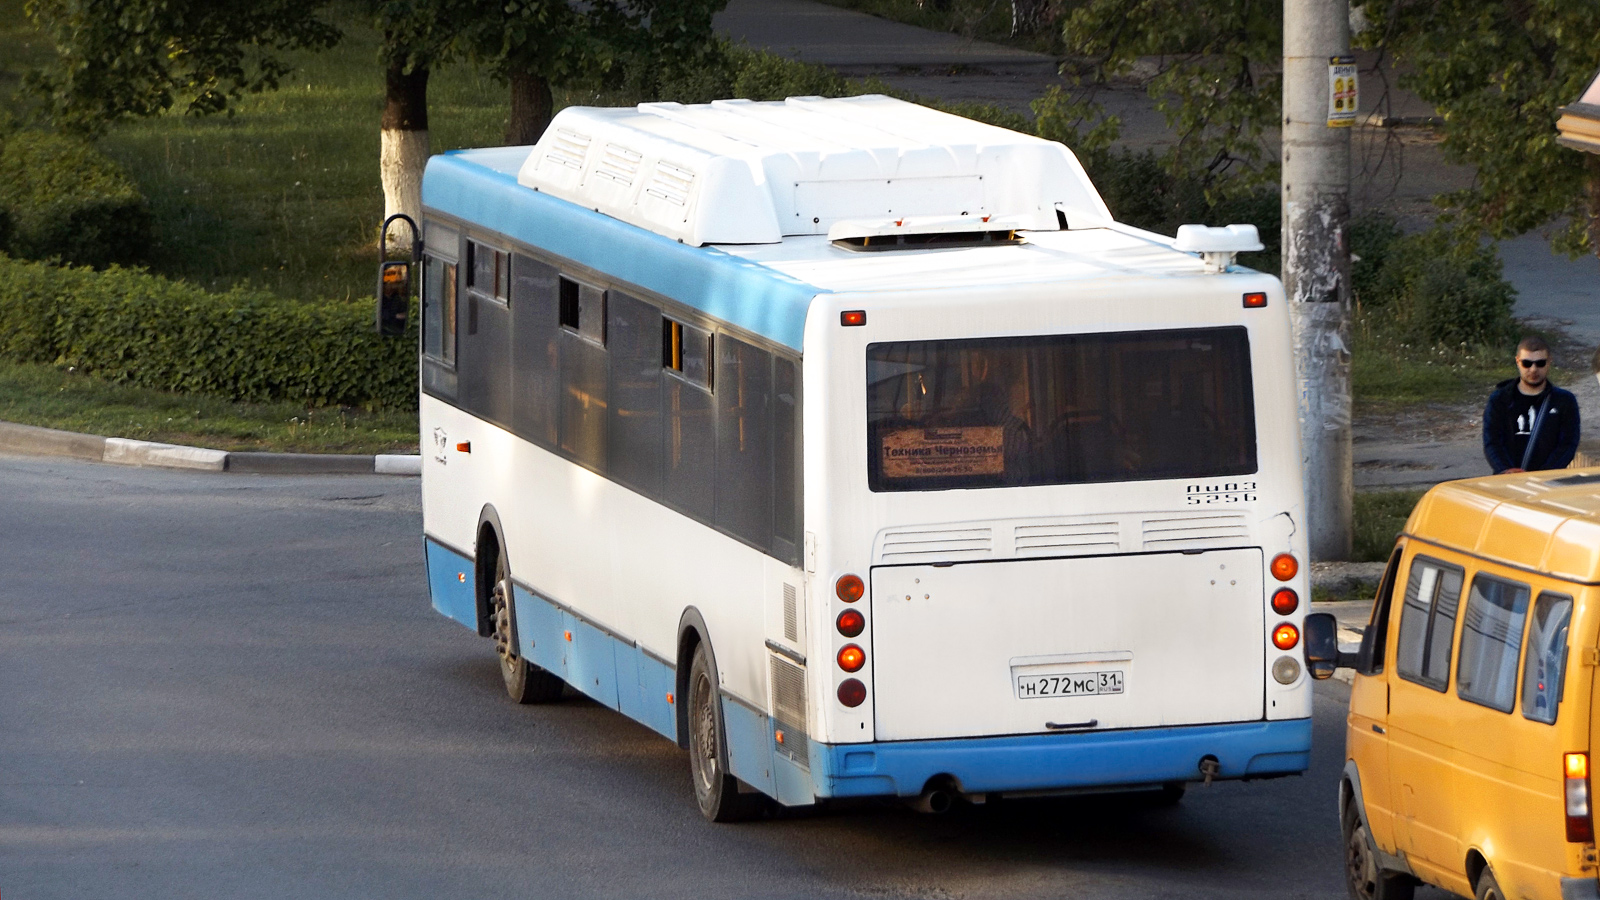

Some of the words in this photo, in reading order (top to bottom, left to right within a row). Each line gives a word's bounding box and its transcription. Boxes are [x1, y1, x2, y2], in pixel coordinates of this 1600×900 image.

[884, 447, 931, 457] Техника
[1187, 493, 1257, 505] 5256
[1100, 674, 1117, 687] 31
